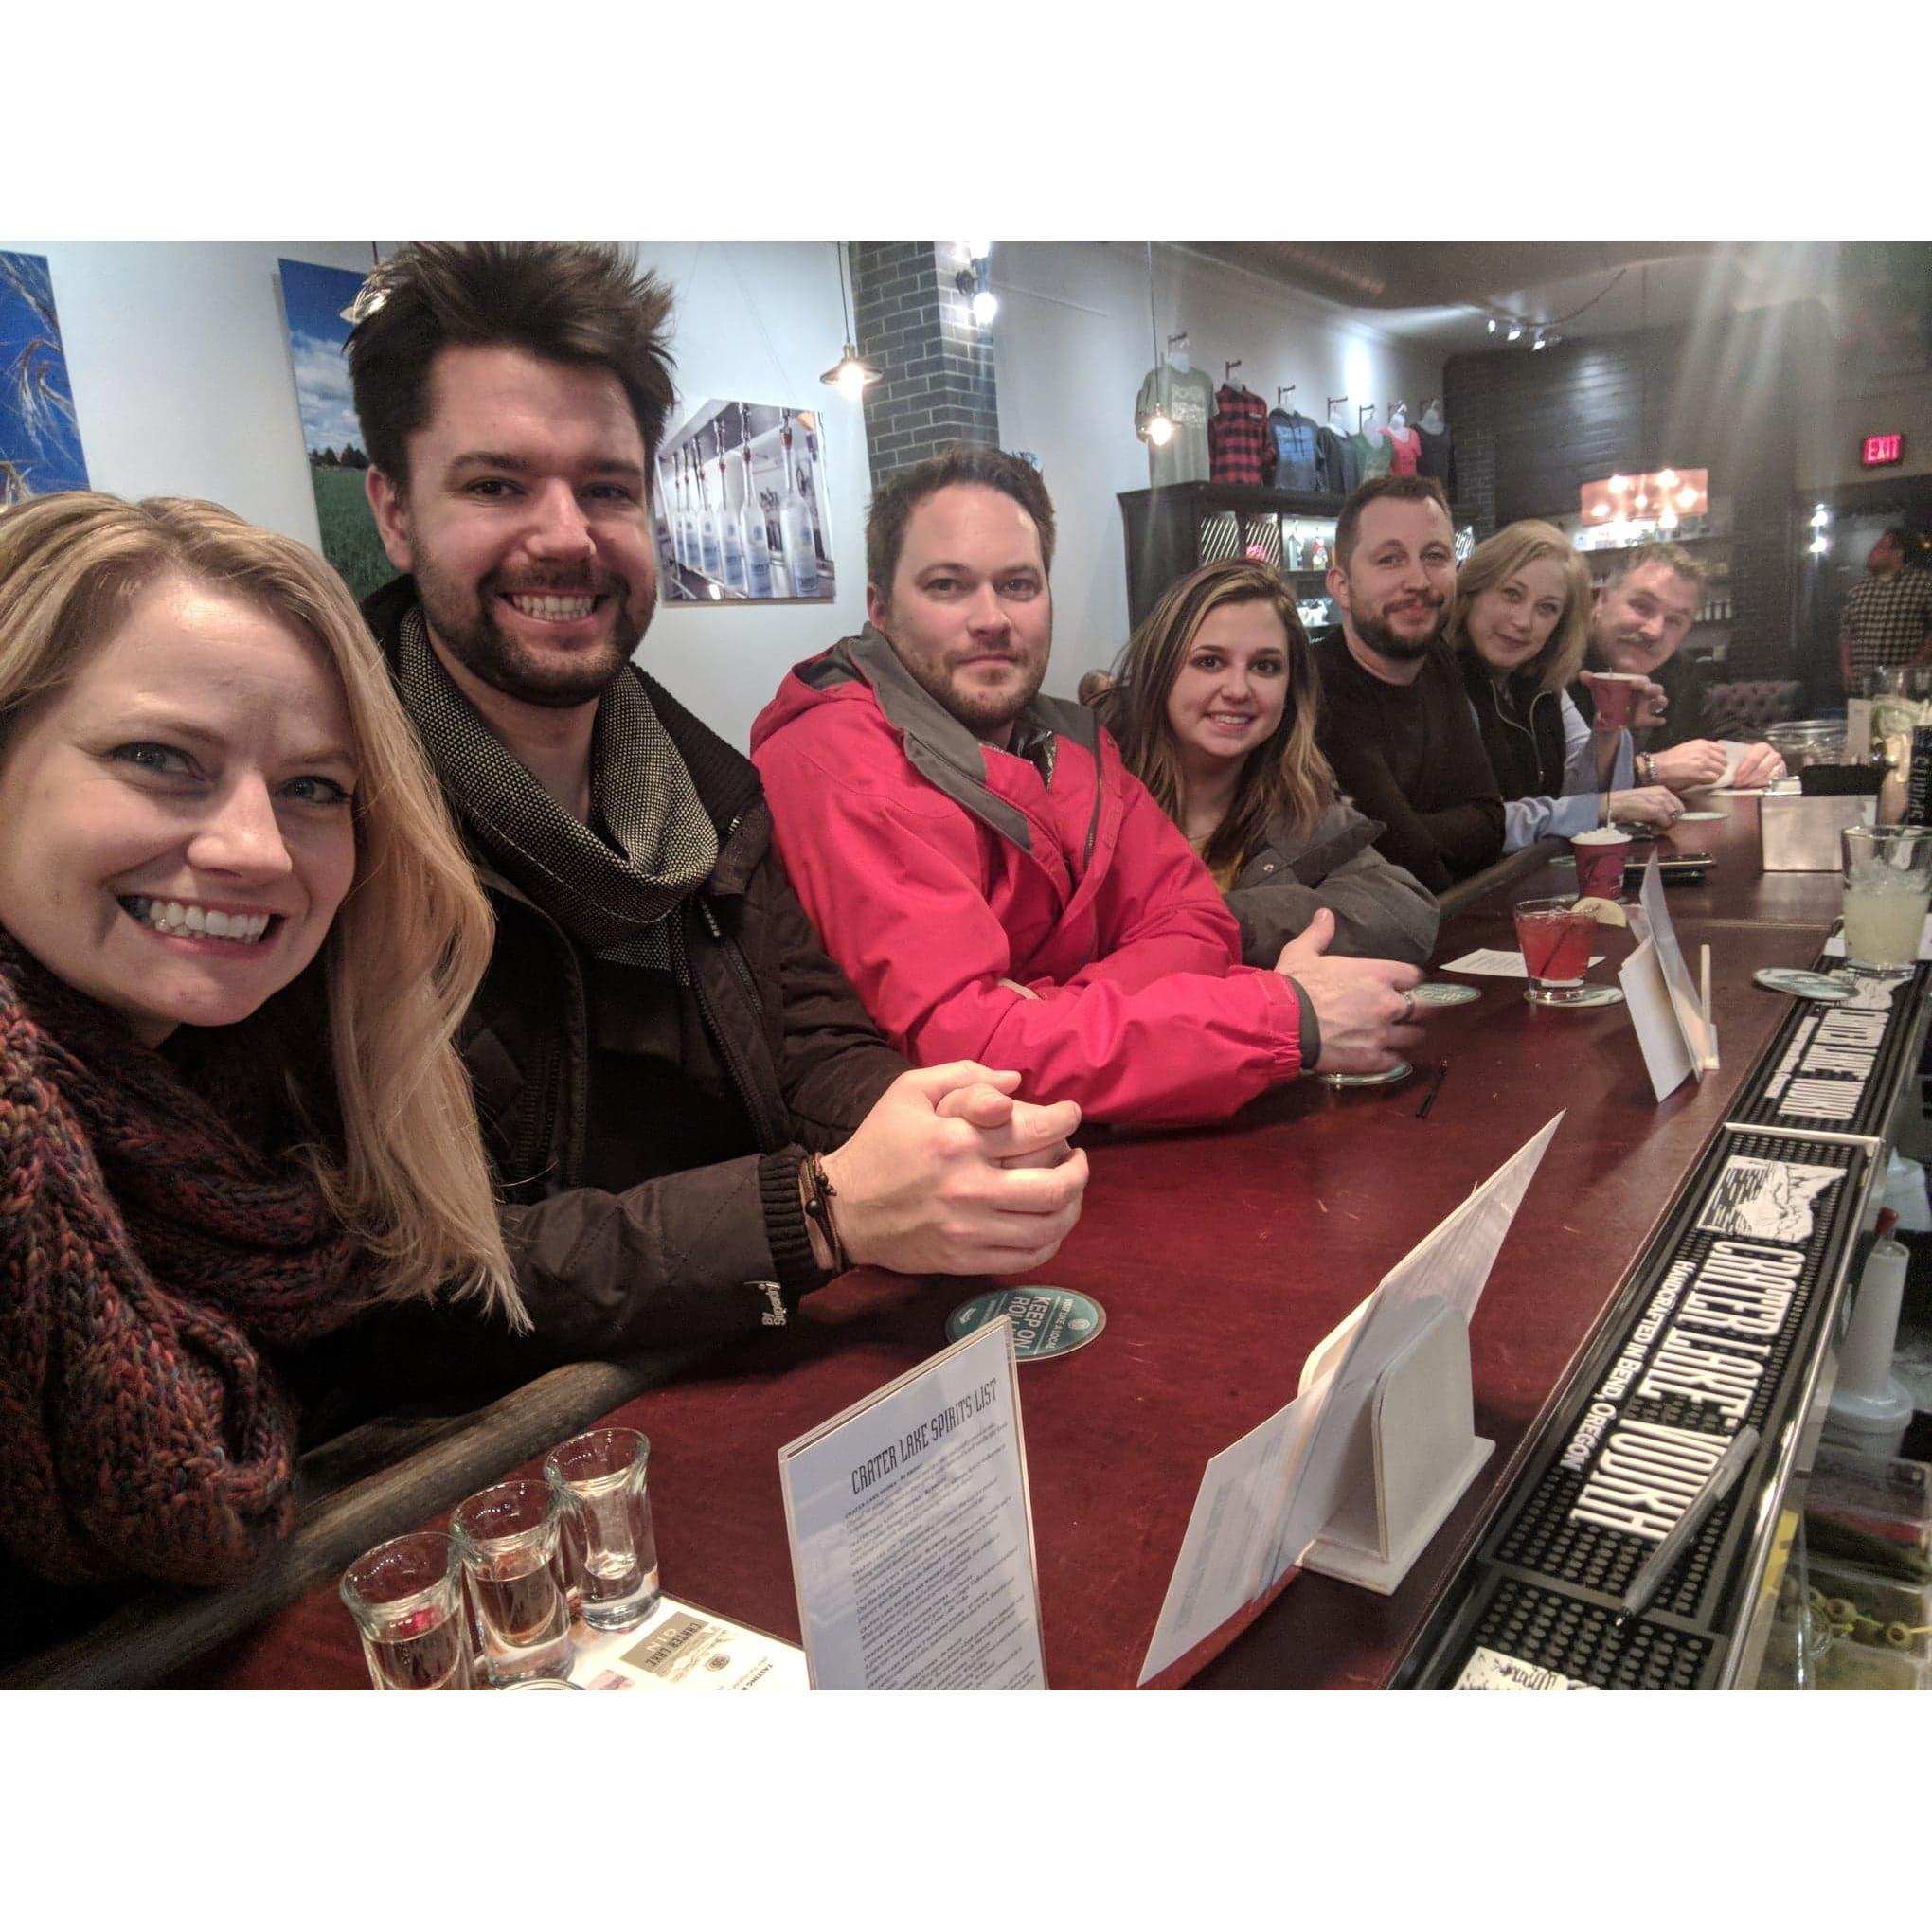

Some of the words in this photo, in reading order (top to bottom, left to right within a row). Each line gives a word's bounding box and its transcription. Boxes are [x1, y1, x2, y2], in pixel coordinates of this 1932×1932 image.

[1867, 436, 1899, 461] EXIT
[1024, 1295, 1052, 1328] KEEP
[1677, 1241, 1806, 1336] CRATER
[1013, 1329, 1037, 1350] ON
[1624, 1343, 1648, 1360] IN
[1637, 1326, 1772, 1419] LAKE
[851, 1445, 898, 1495] CRATER
[899, 1423, 930, 1464] LAKE
[930, 1395, 974, 1442] SPIRITS
[974, 1378, 997, 1413] LIST
[1560, 1402, 1617, 1471] OREGON
[1569, 1418, 1733, 1541] VODKA
[644, 1647, 671, 1667] LAKE
